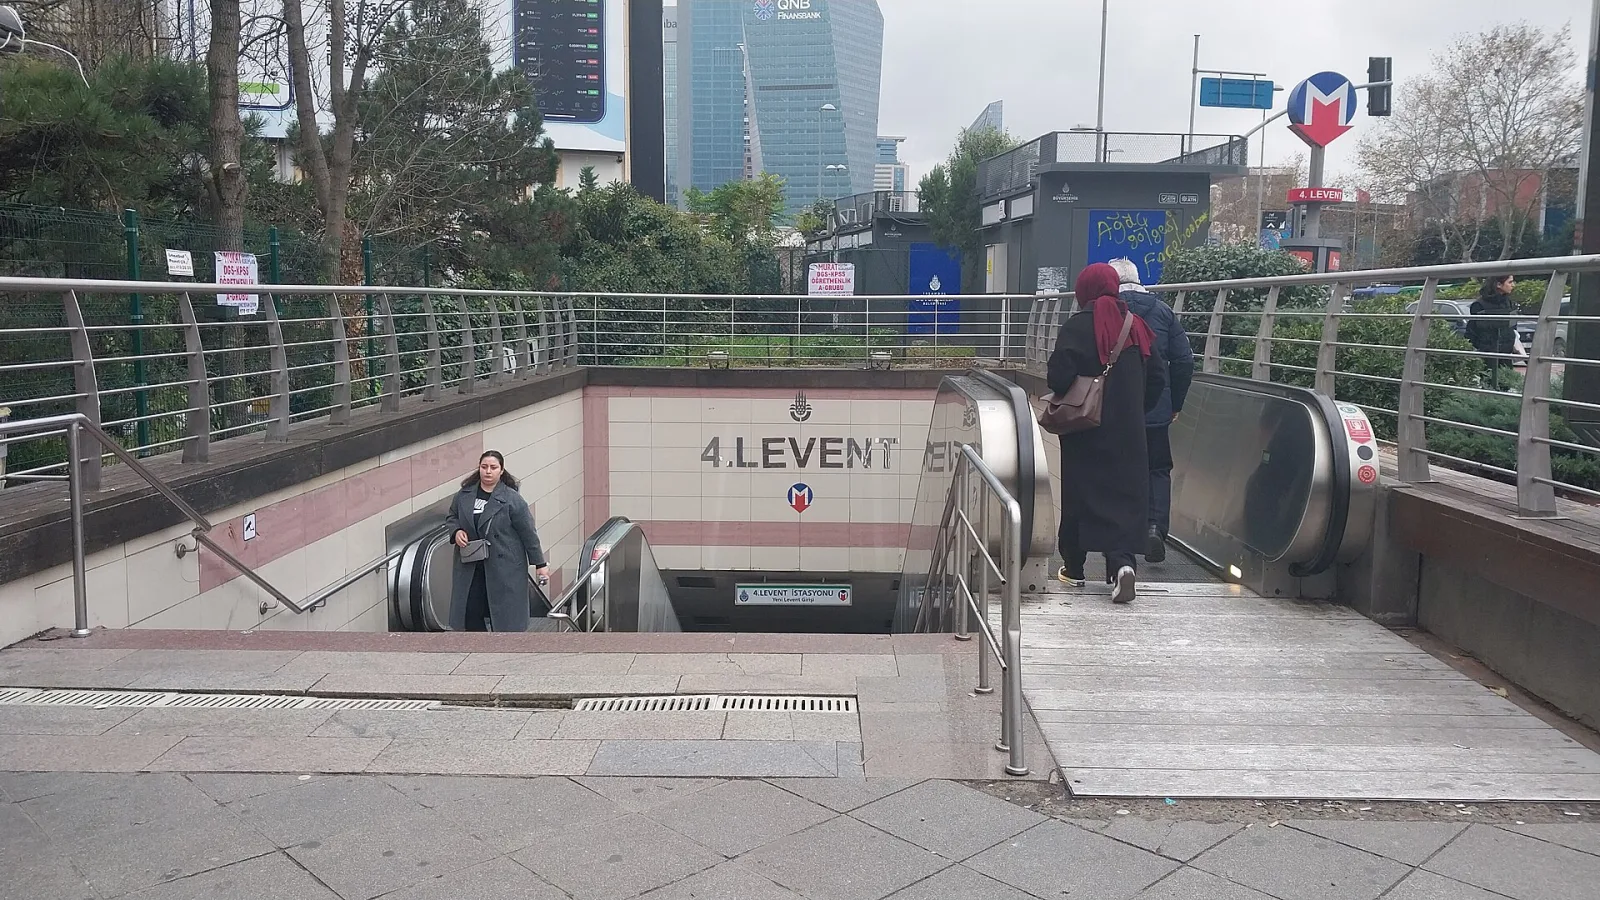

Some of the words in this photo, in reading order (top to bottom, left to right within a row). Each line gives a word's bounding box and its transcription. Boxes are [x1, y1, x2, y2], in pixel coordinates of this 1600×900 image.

[777, 0, 811, 10] QNB
[1299, 190, 1308, 199] 4.
[1310, 190, 1342, 200] LEVENT
[223, 265, 249, 276] DGS-KPSS
[818, 263, 838, 271] MURAT
[700, 436, 900, 469] 4.LEVENT
[753, 589, 788, 597] 4.LEVENT
[791, 588, 834, 597] İSTASYONU
